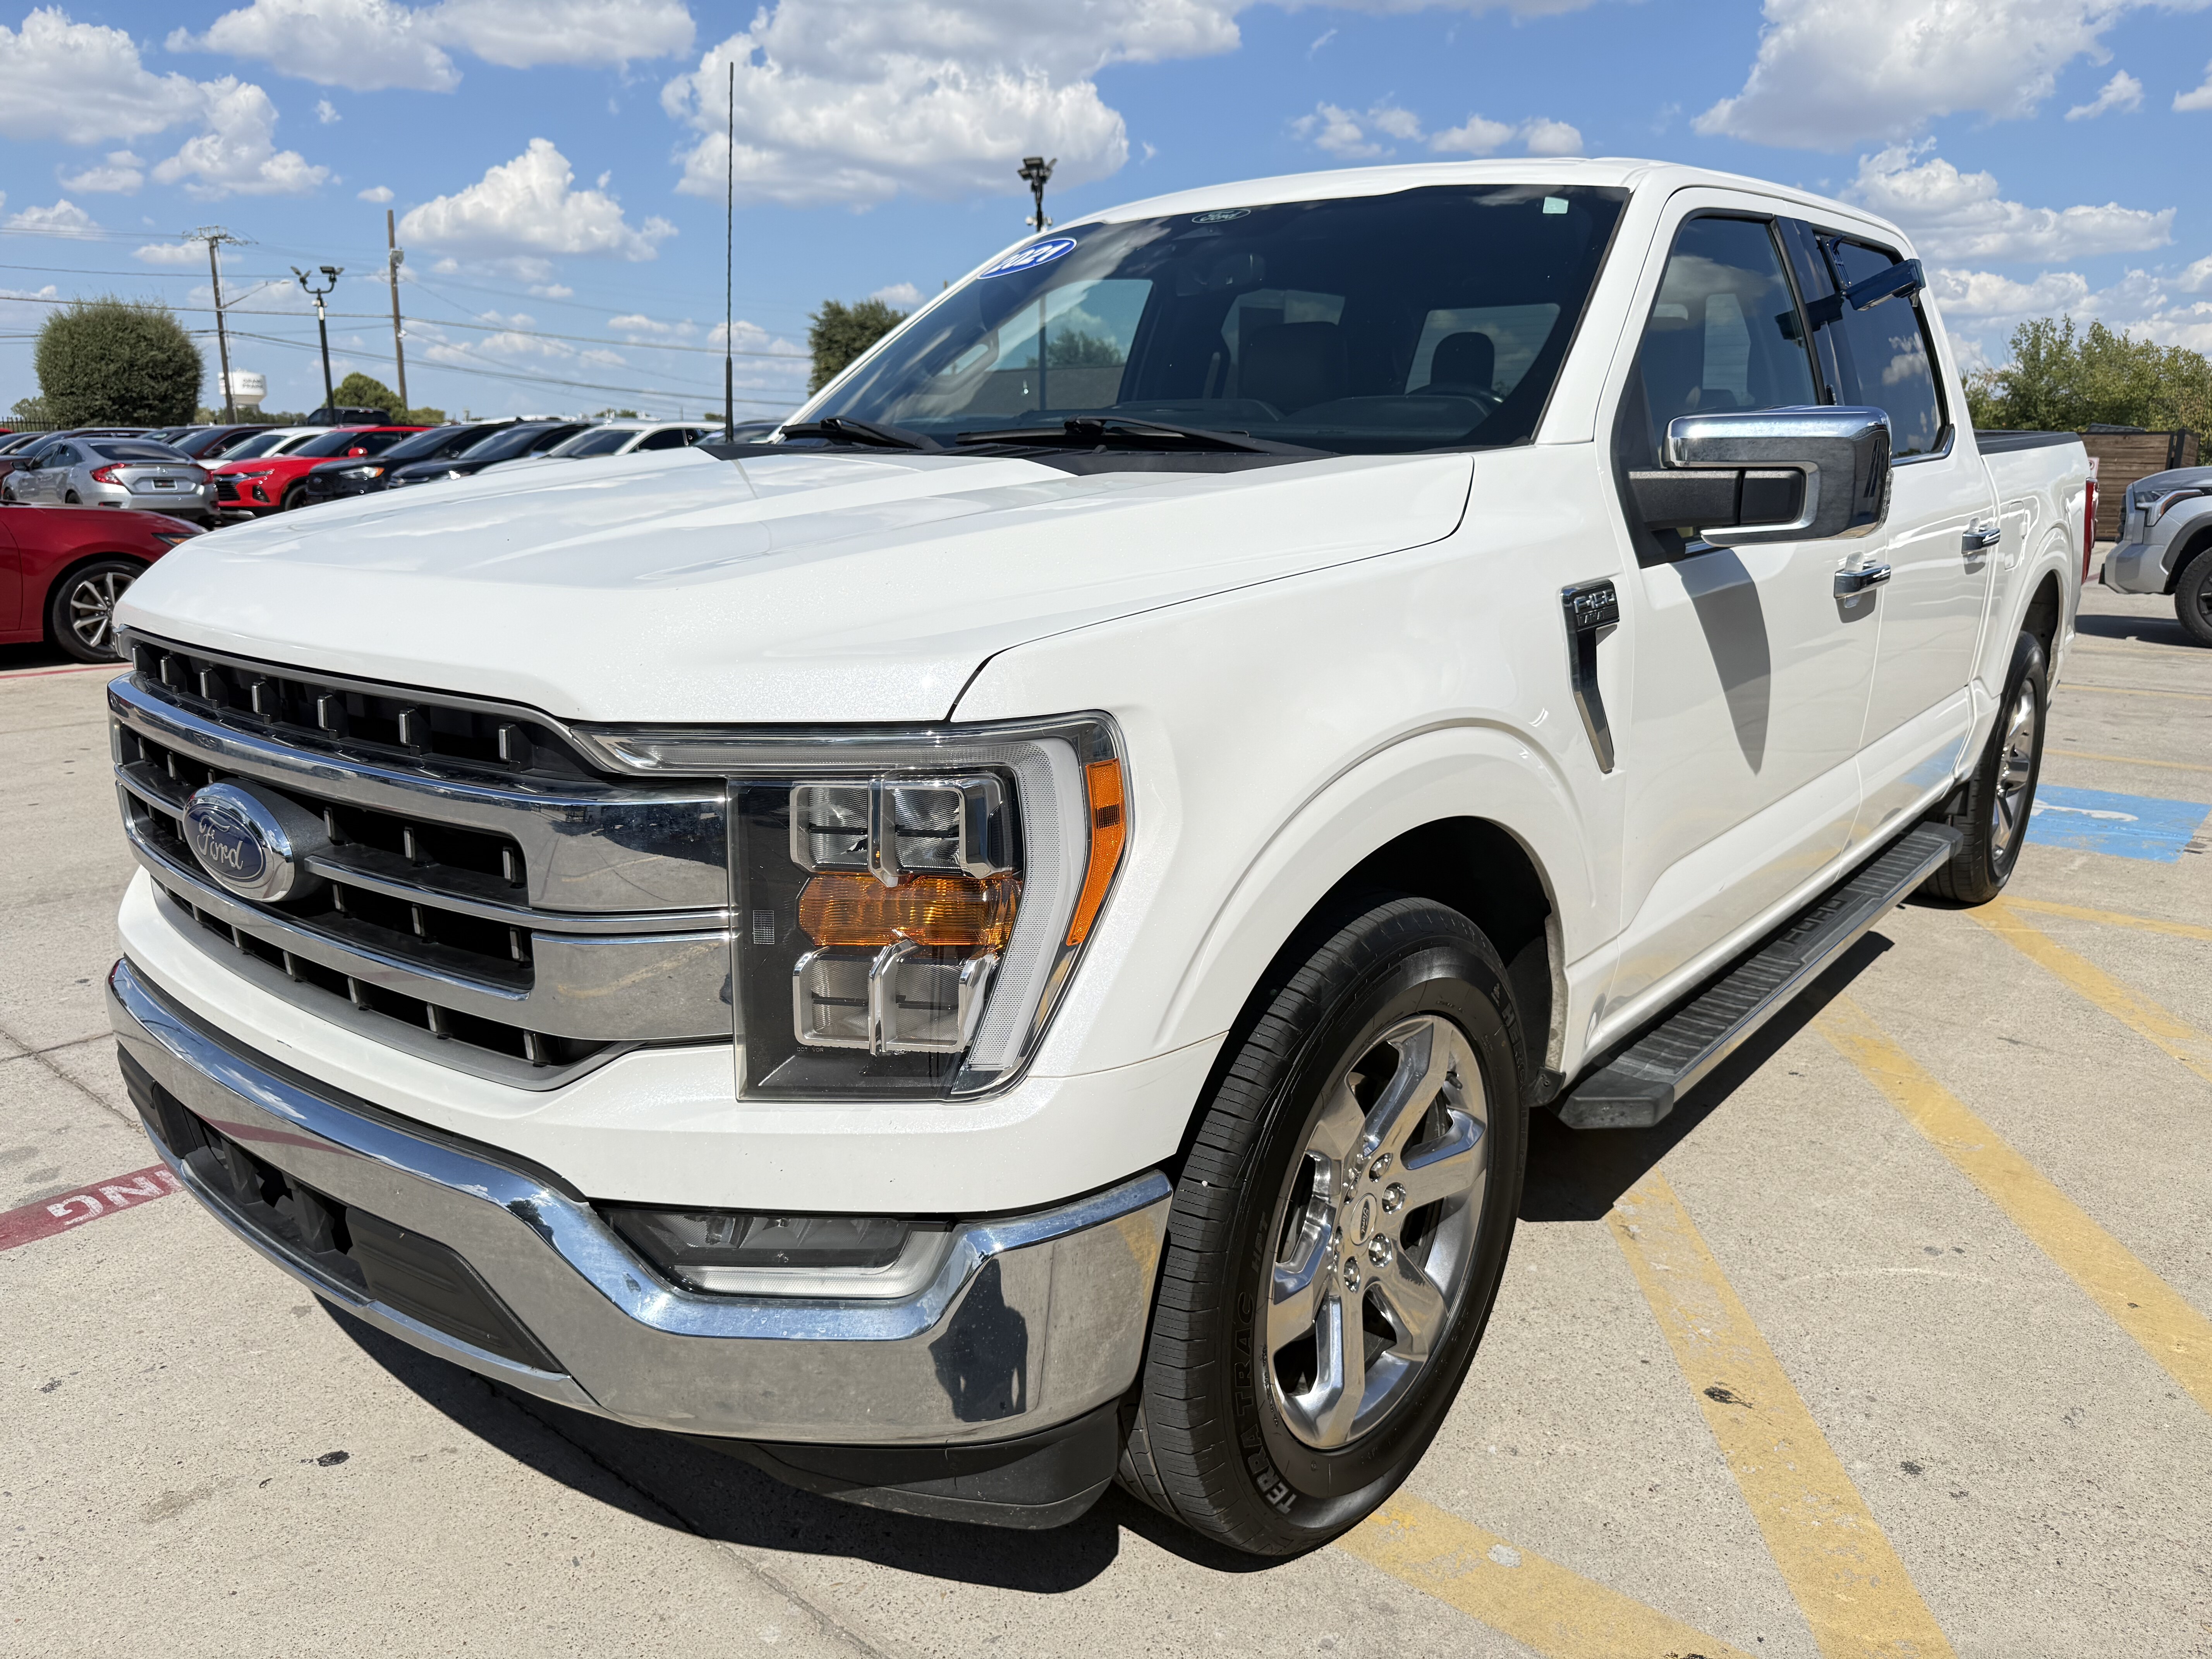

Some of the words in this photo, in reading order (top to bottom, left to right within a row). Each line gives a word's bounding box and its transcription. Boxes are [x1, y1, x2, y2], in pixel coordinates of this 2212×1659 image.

[1200, 211, 1242, 222] Ford
[982, 242, 1071, 276] 2021
[1573, 589, 1616, 613] F-150
[196, 815, 244, 870] Ford
[1778, 898, 1848, 944] FORD
[1361, 1207, 1369, 1233] Ford
[1235, 1291, 1254, 1417] TRAC
[1240, 1423, 1297, 1514] TERRA
